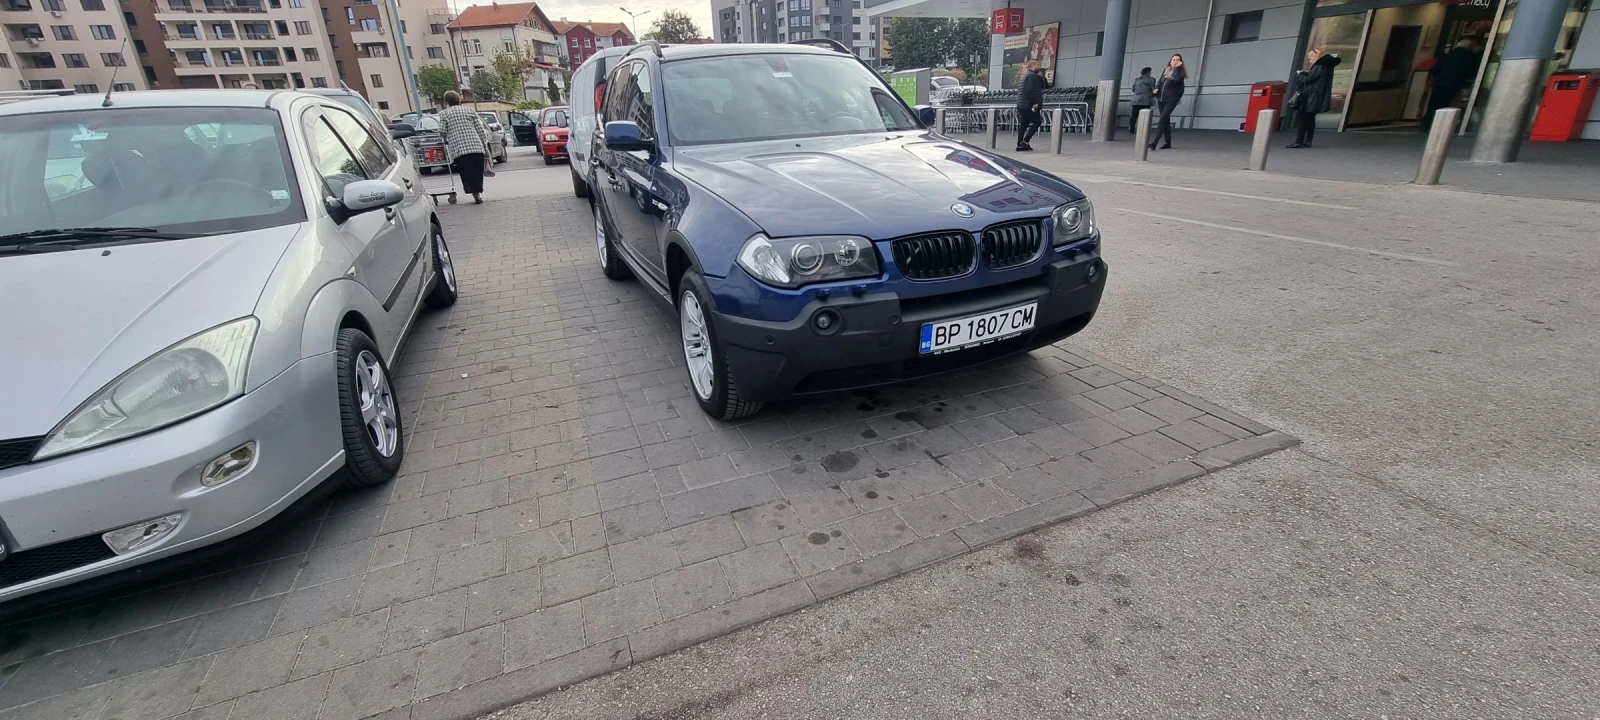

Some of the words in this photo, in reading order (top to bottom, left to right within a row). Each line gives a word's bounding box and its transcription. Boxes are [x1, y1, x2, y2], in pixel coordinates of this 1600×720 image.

[935, 323, 961, 346] BP
[967, 313, 1009, 340] 1807
[1011, 306, 1034, 329] CM
[921, 340, 931, 349] BG
